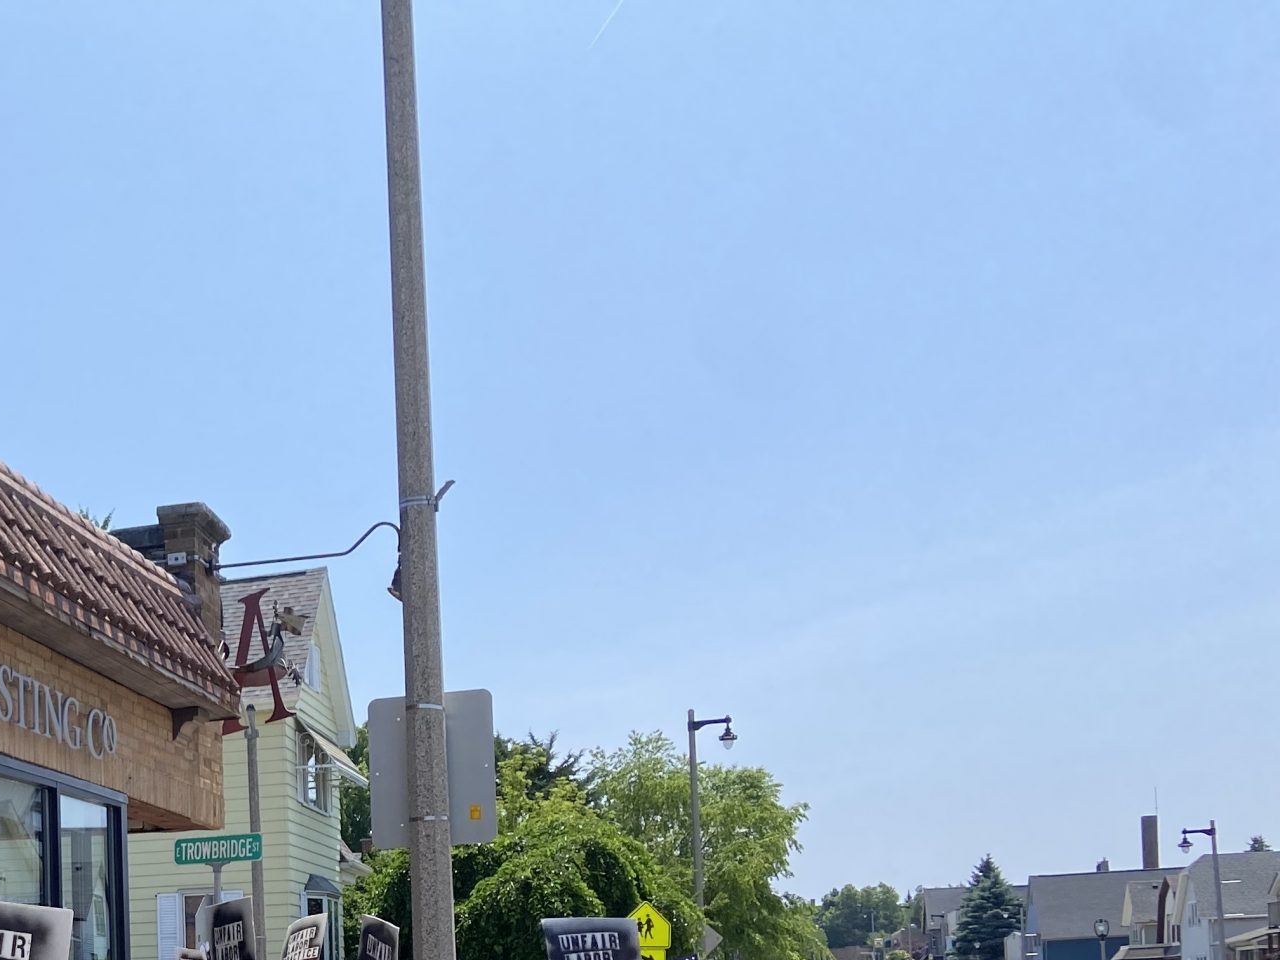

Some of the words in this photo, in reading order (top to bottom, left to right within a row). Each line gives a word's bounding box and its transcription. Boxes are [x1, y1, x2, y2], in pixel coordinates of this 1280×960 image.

[87, 708, 117, 760] CO
[176, 847, 181, 857] E
[181, 838, 253, 860] TROWBRIDGE
[252, 842, 260, 852] ST
[561, 932, 618, 951] UNFAIR
